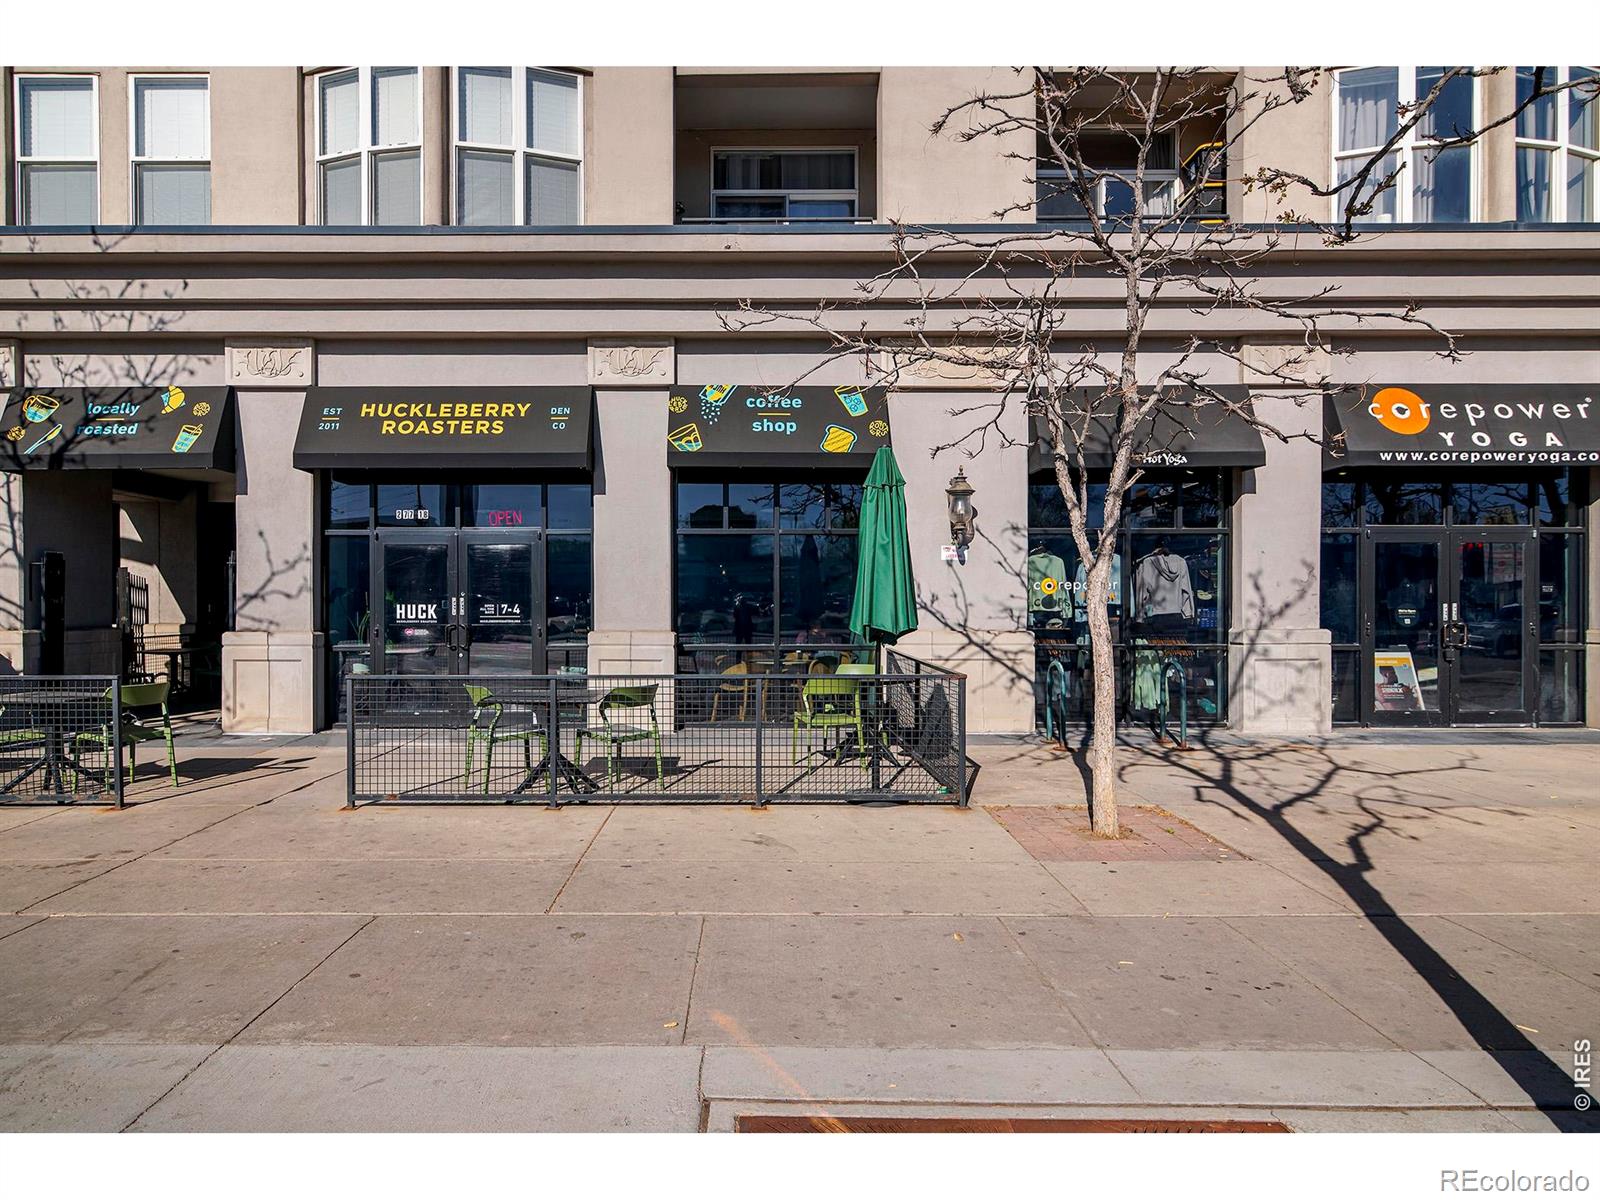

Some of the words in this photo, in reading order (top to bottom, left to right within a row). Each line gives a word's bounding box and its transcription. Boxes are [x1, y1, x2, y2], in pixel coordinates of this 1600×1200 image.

[87, 402, 140, 417] locally
[323, 407, 343, 415] EST
[360, 403, 532, 418] HUCKLEBERRY
[550, 407, 571, 415] DEN
[1367, 402, 1590, 427] corepower
[76, 423, 138, 435] roasted
[318, 422, 340, 430] 2011
[381, 420, 505, 435] ROASTERS
[552, 422, 566, 430] CO
[752, 418, 797, 435] shop
[1438, 432, 1564, 447] YOGA
[1162, 452, 1188, 466] Yoga
[1379, 451, 1600, 464] www.corepoweryoga.co
[488, 511, 523, 527] OPEN
[1033, 581, 1118, 594] corepor
[396, 604, 437, 619] HUCK
[501, 604, 520, 614] 7-4
